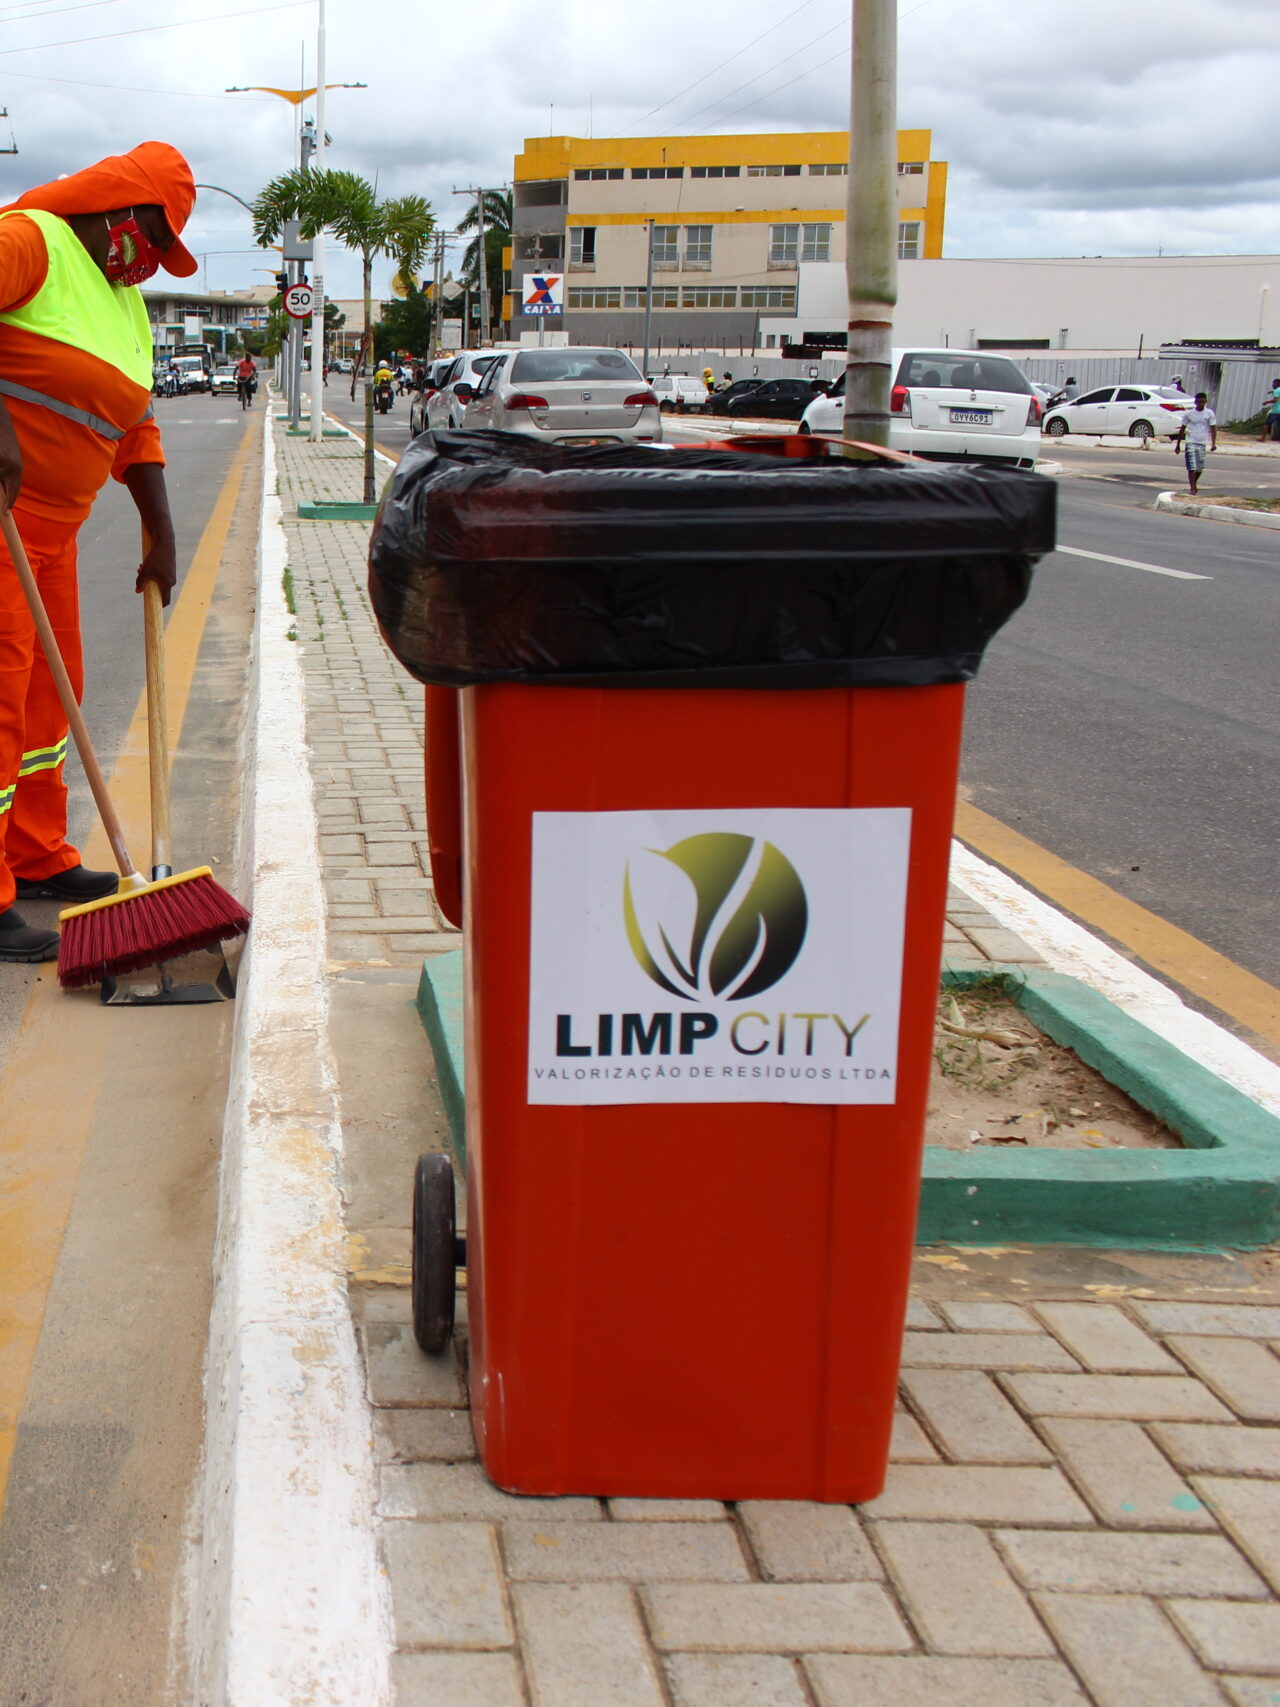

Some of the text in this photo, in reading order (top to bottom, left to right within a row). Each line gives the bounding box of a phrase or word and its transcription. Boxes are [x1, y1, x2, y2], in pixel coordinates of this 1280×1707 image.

[291, 293, 310, 306] 50
[524, 305, 561, 314] CAIXA
[556, 1011, 872, 1057] LIMP CITY
[535, 1064, 892, 1081] VALORIZAÇÃO DE RESÍDUOS LTDA
